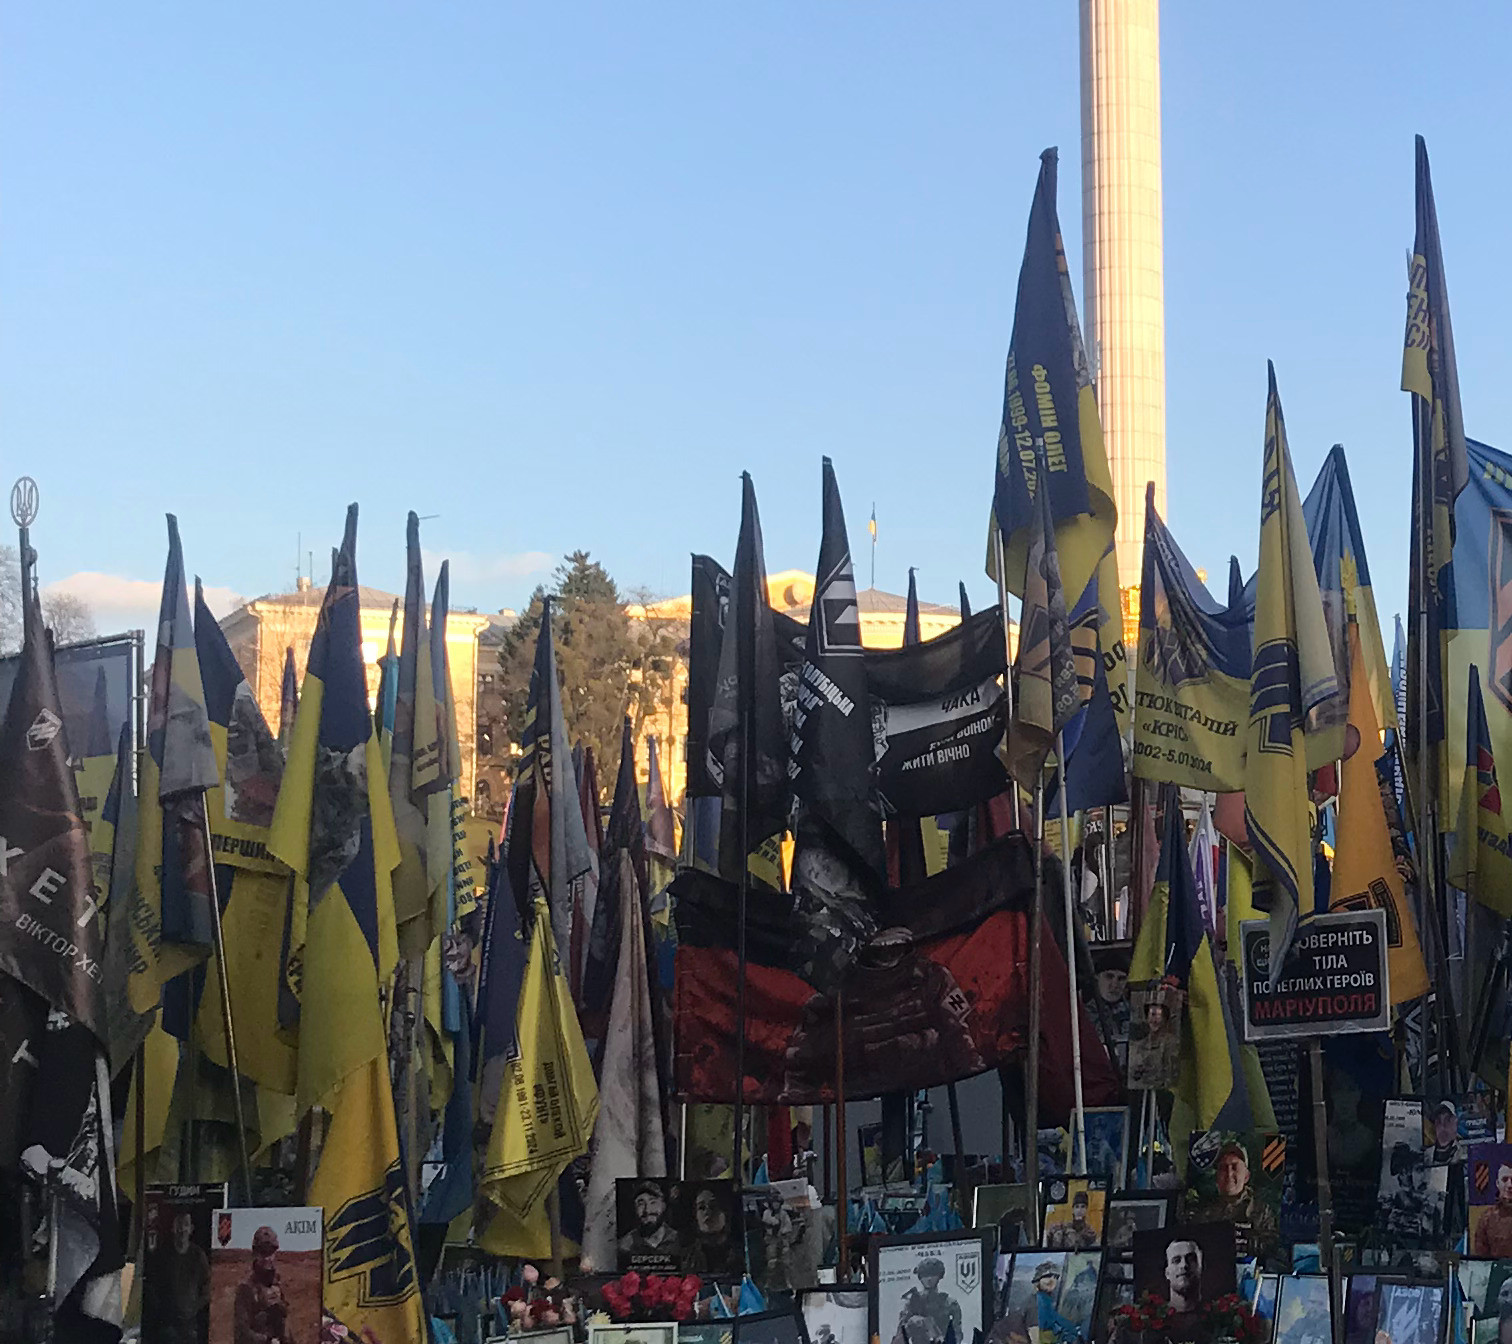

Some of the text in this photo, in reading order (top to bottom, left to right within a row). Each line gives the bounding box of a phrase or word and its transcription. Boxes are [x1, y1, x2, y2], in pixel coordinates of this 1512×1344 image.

[1032, 364, 1068, 473] ФОМІН ОЛЕГ
[941, 688, 981, 714] ЧАКА
[901, 743, 970, 771] ЖИТИ ВІЧНО
[15, 912, 79, 958] ВІКТОР
[1300, 930, 1373, 950] ОВЕРНІТЬ
[1312, 954, 1348, 971] ТІЛА
[1326, 970, 1375, 989] ГЕРОЇВ
[1254, 992, 1377, 1021] МАРІУПОЛЯ
